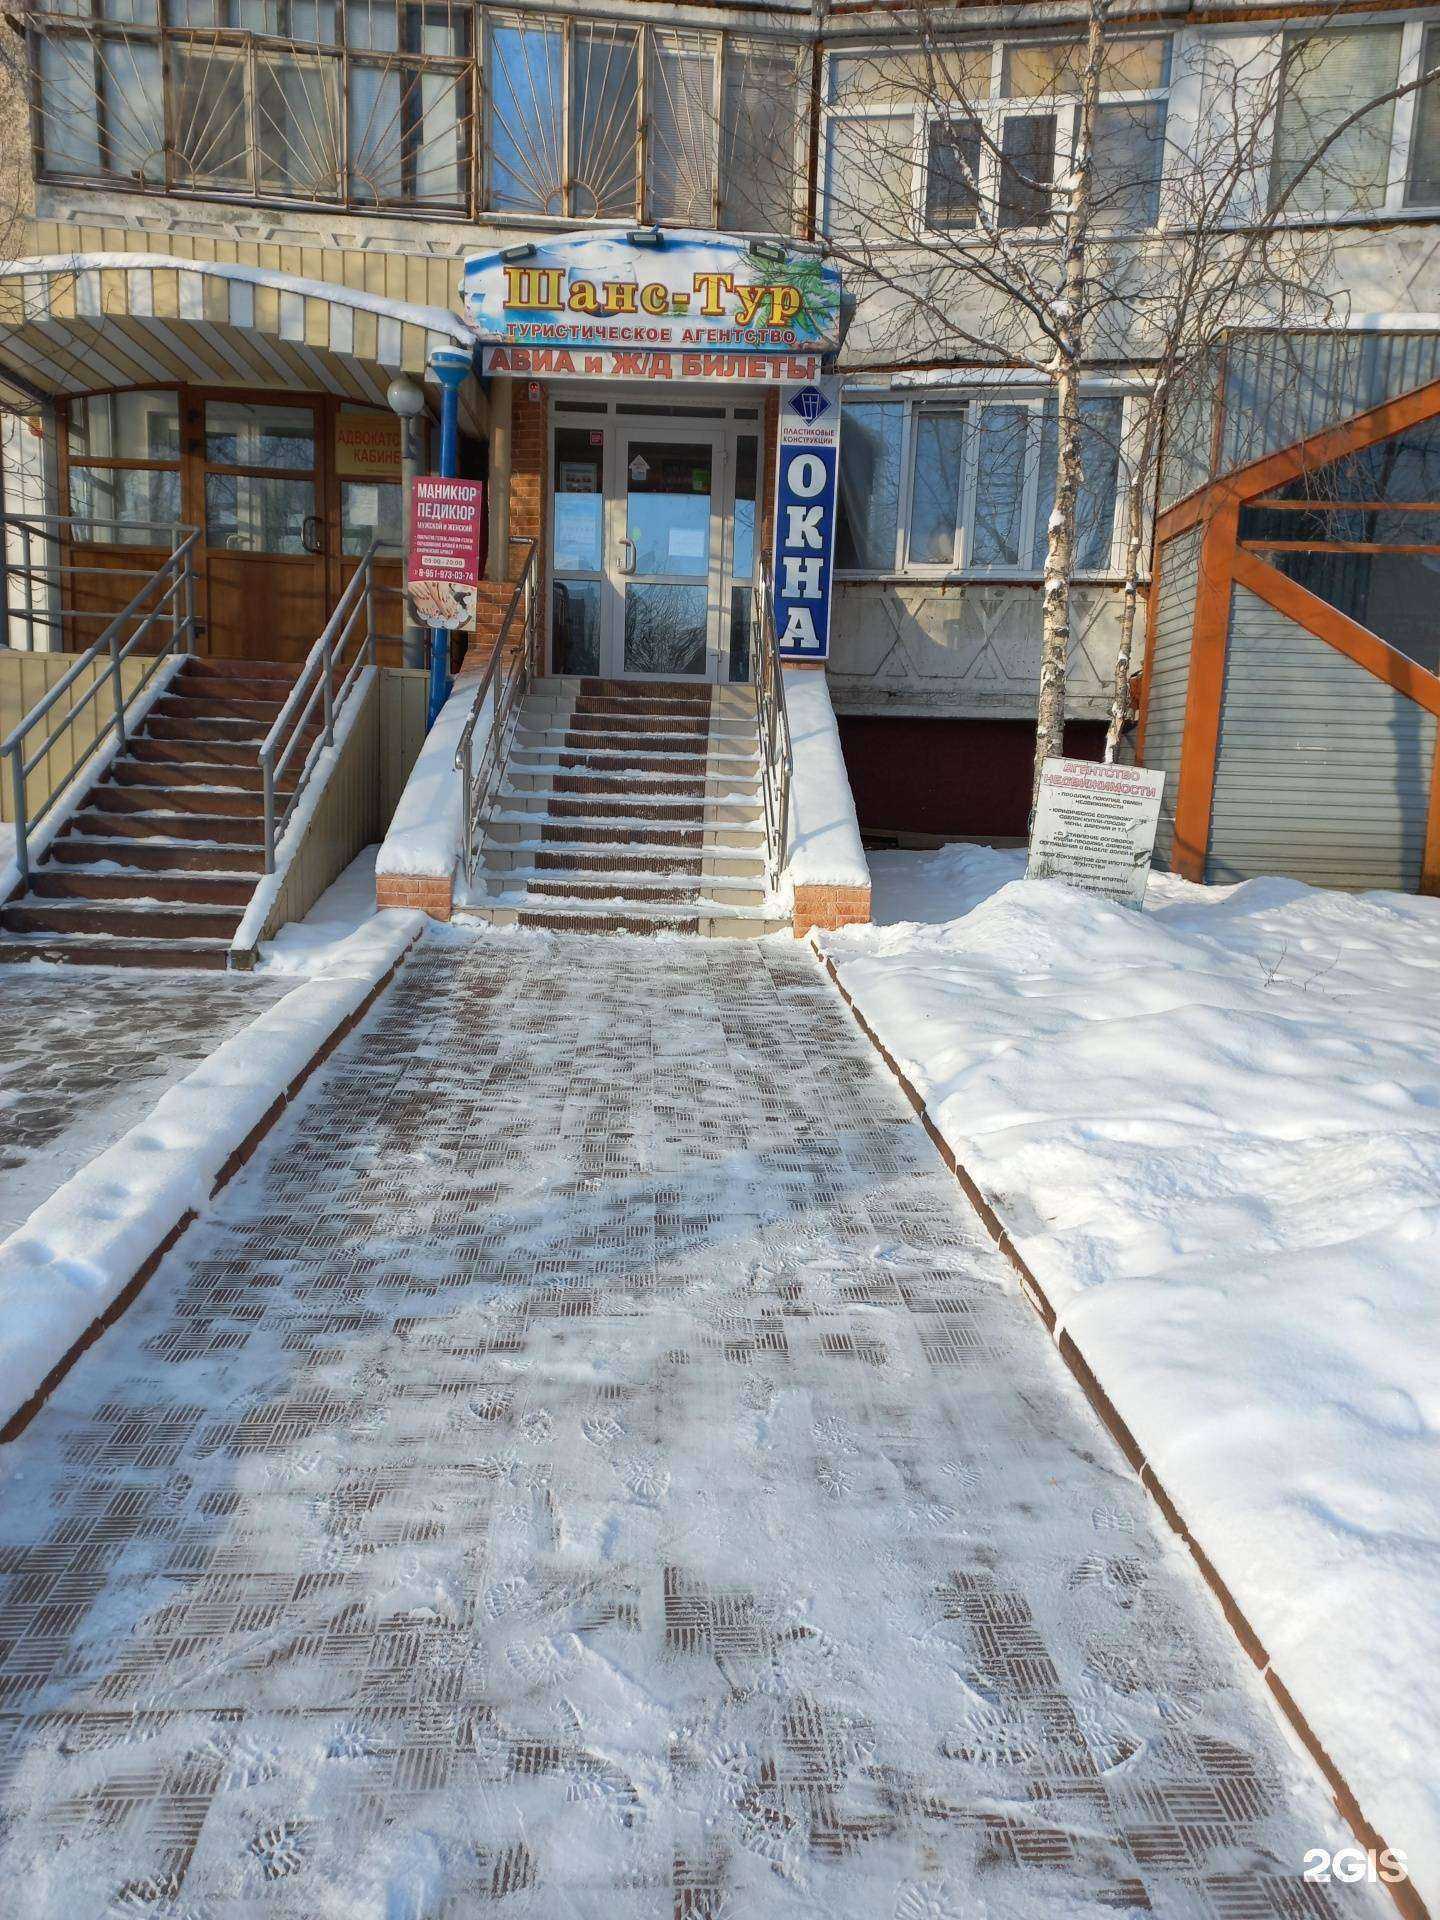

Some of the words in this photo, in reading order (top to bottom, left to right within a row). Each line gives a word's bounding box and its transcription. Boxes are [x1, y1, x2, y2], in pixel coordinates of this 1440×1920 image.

[503, 266, 803, 326] Шанс-Тур
[506, 323, 672, 343] ТУРИСТИЧЕСКОЕ
[681, 327, 798, 345] АГЕНТСТВО
[488, 348, 579, 372] АВИА
[611, 351, 674, 379] Ж/Д
[681, 354, 816, 380] БИЛЕТЫ
[783, 428, 835, 437] ПЛАСТИКОВЫЕ
[783, 436, 833, 445] КОНСТРУКЦИИ
[353, 448, 402, 464] КАБИНЕ
[417, 483, 477, 502] МАНИКЮР
[417, 502, 475, 520] ПЕДИКЮР
[417, 521, 443, 530] МУЖСКОЙ
[448, 523, 472, 532] ЖЕНСКИЙ
[780, 453, 827, 649] ОКНА
[1062, 763, 1140, 782] АГЕНТСТВО
[1044, 774, 1157, 797] НЕДВИЖИМОСТИ
[1052, 808, 1095, 817] ЮРИДИЧЕСКОЕ
[1075, 800, 1124, 809] НЕДВИЖИМОСТИ
